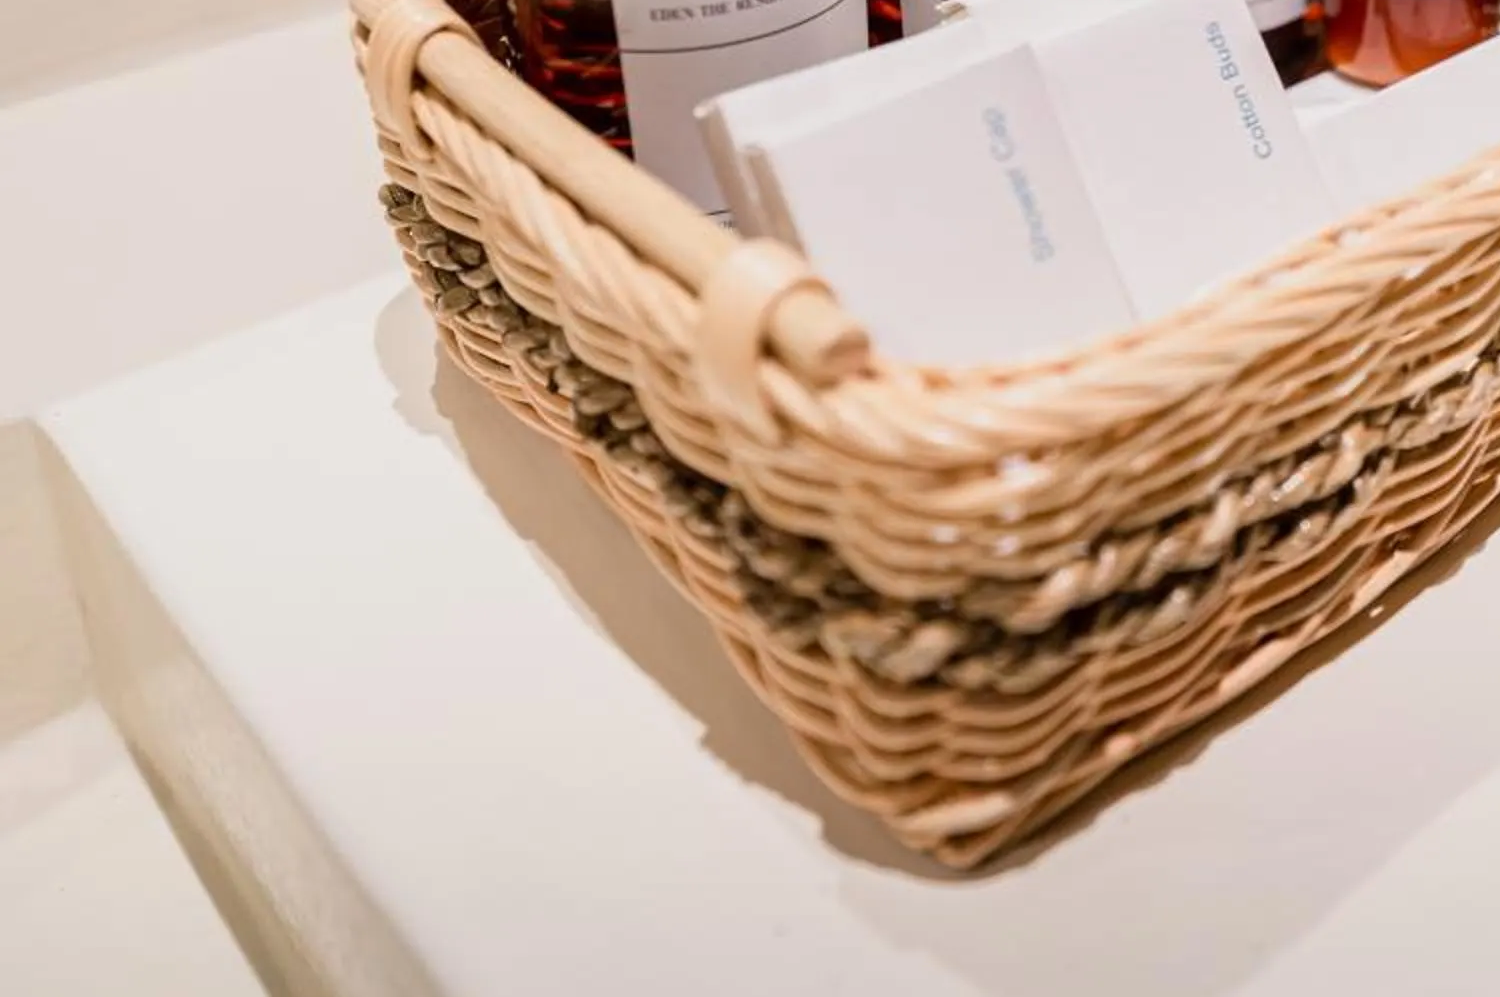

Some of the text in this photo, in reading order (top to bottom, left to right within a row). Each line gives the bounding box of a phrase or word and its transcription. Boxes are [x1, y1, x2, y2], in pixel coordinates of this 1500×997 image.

[650, 7, 694, 23] EDEN
[701, 1, 731, 19] THE
[1204, 20, 1274, 161] Cotton Buds
